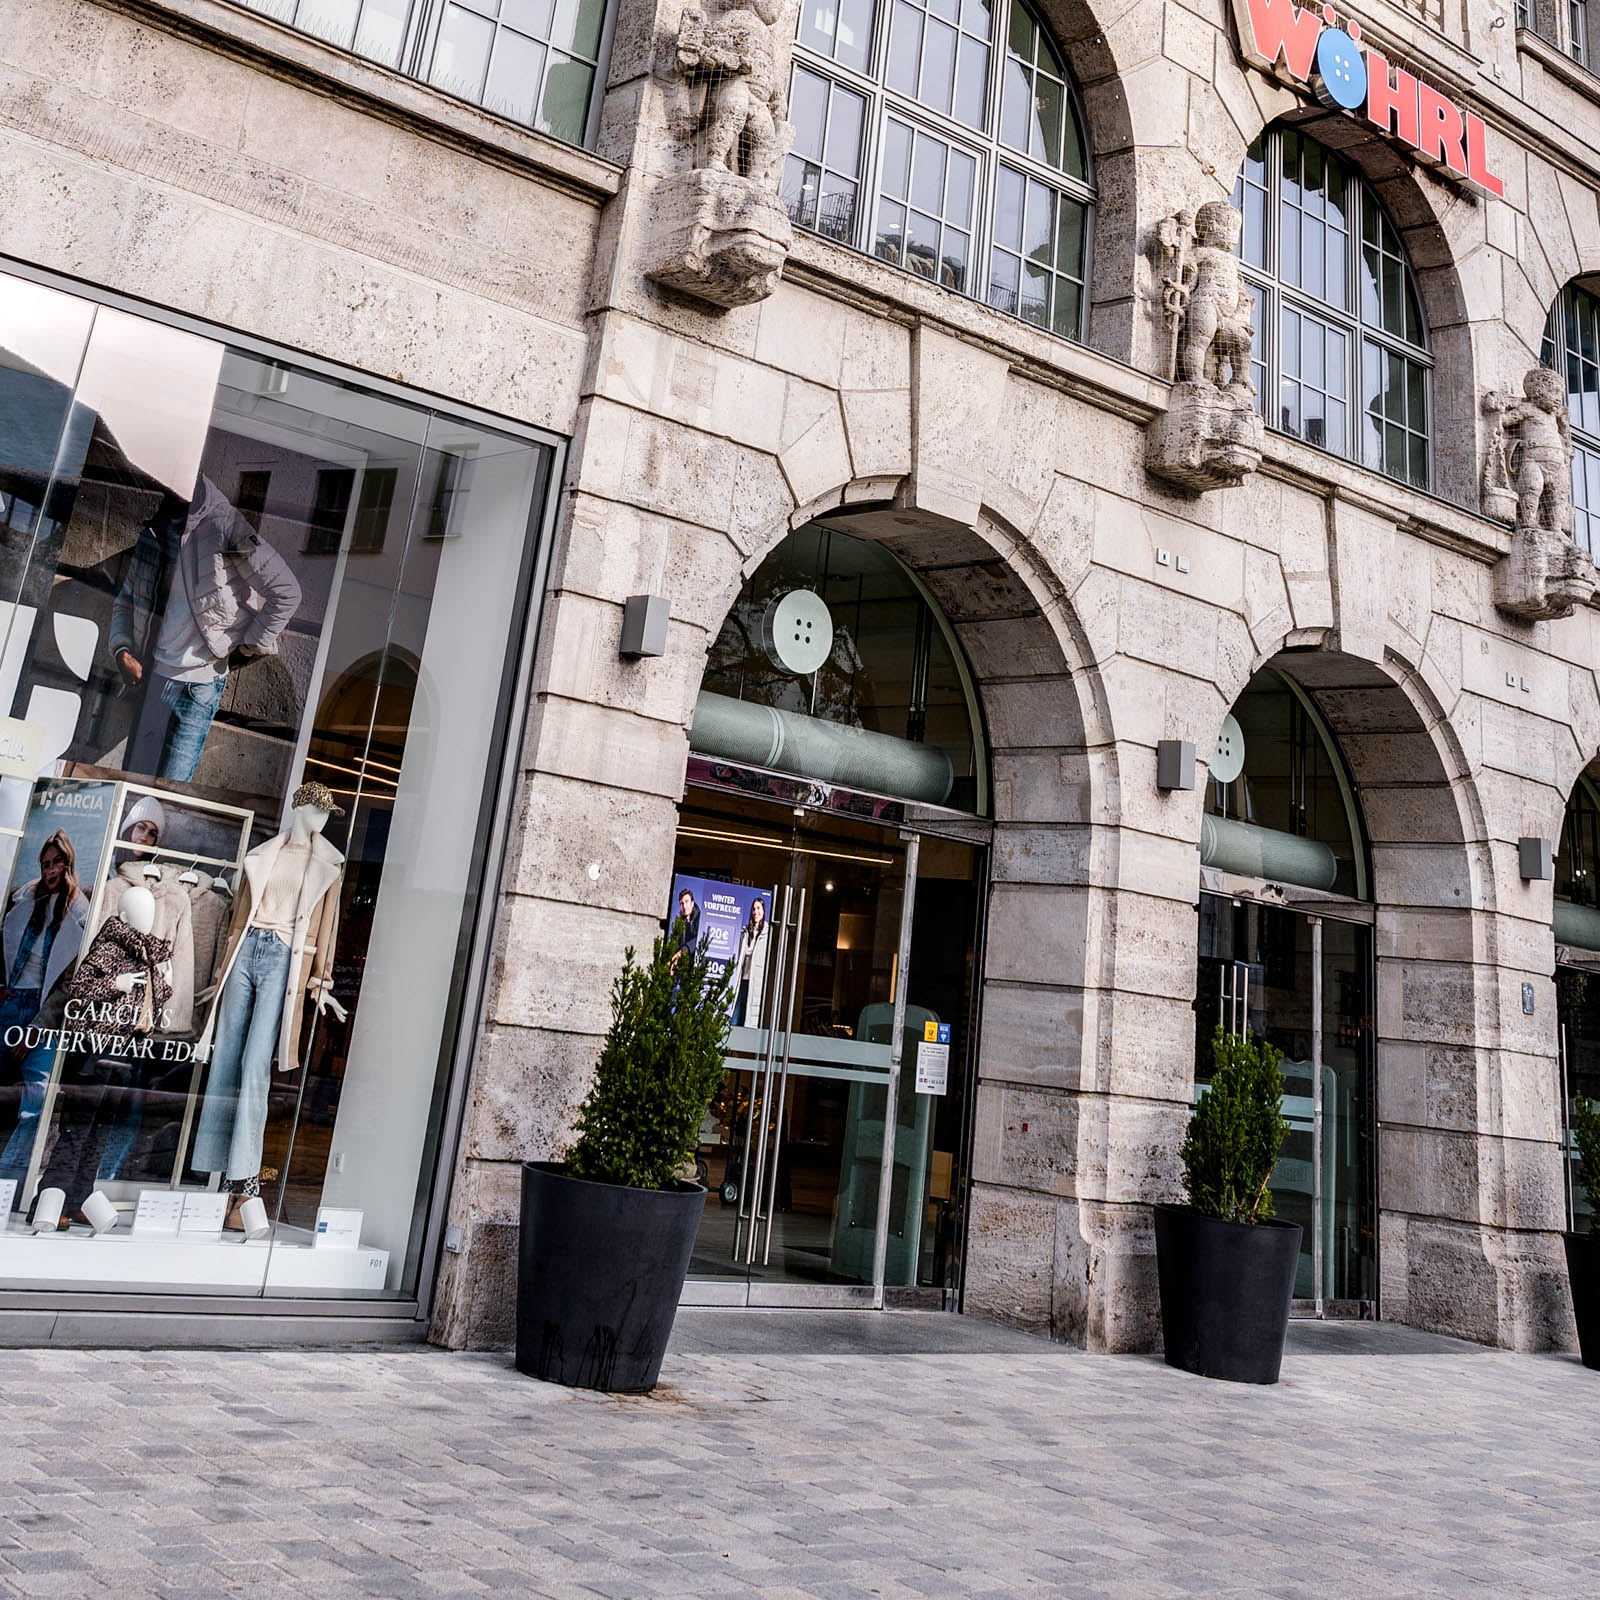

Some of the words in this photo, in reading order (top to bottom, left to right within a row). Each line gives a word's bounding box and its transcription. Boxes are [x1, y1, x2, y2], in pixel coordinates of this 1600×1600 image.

[55, 791, 104, 810] GARCIA
[711, 893, 736, 905] WINTER
[704, 901, 741, 914] VORFREUDE
[64, 998, 174, 1030] GARCIA'S
[3, 1025, 156, 1060] OUTERWEAR
[161, 1039, 217, 1065] EDIT
[369, 1258, 383, 1268] F01
